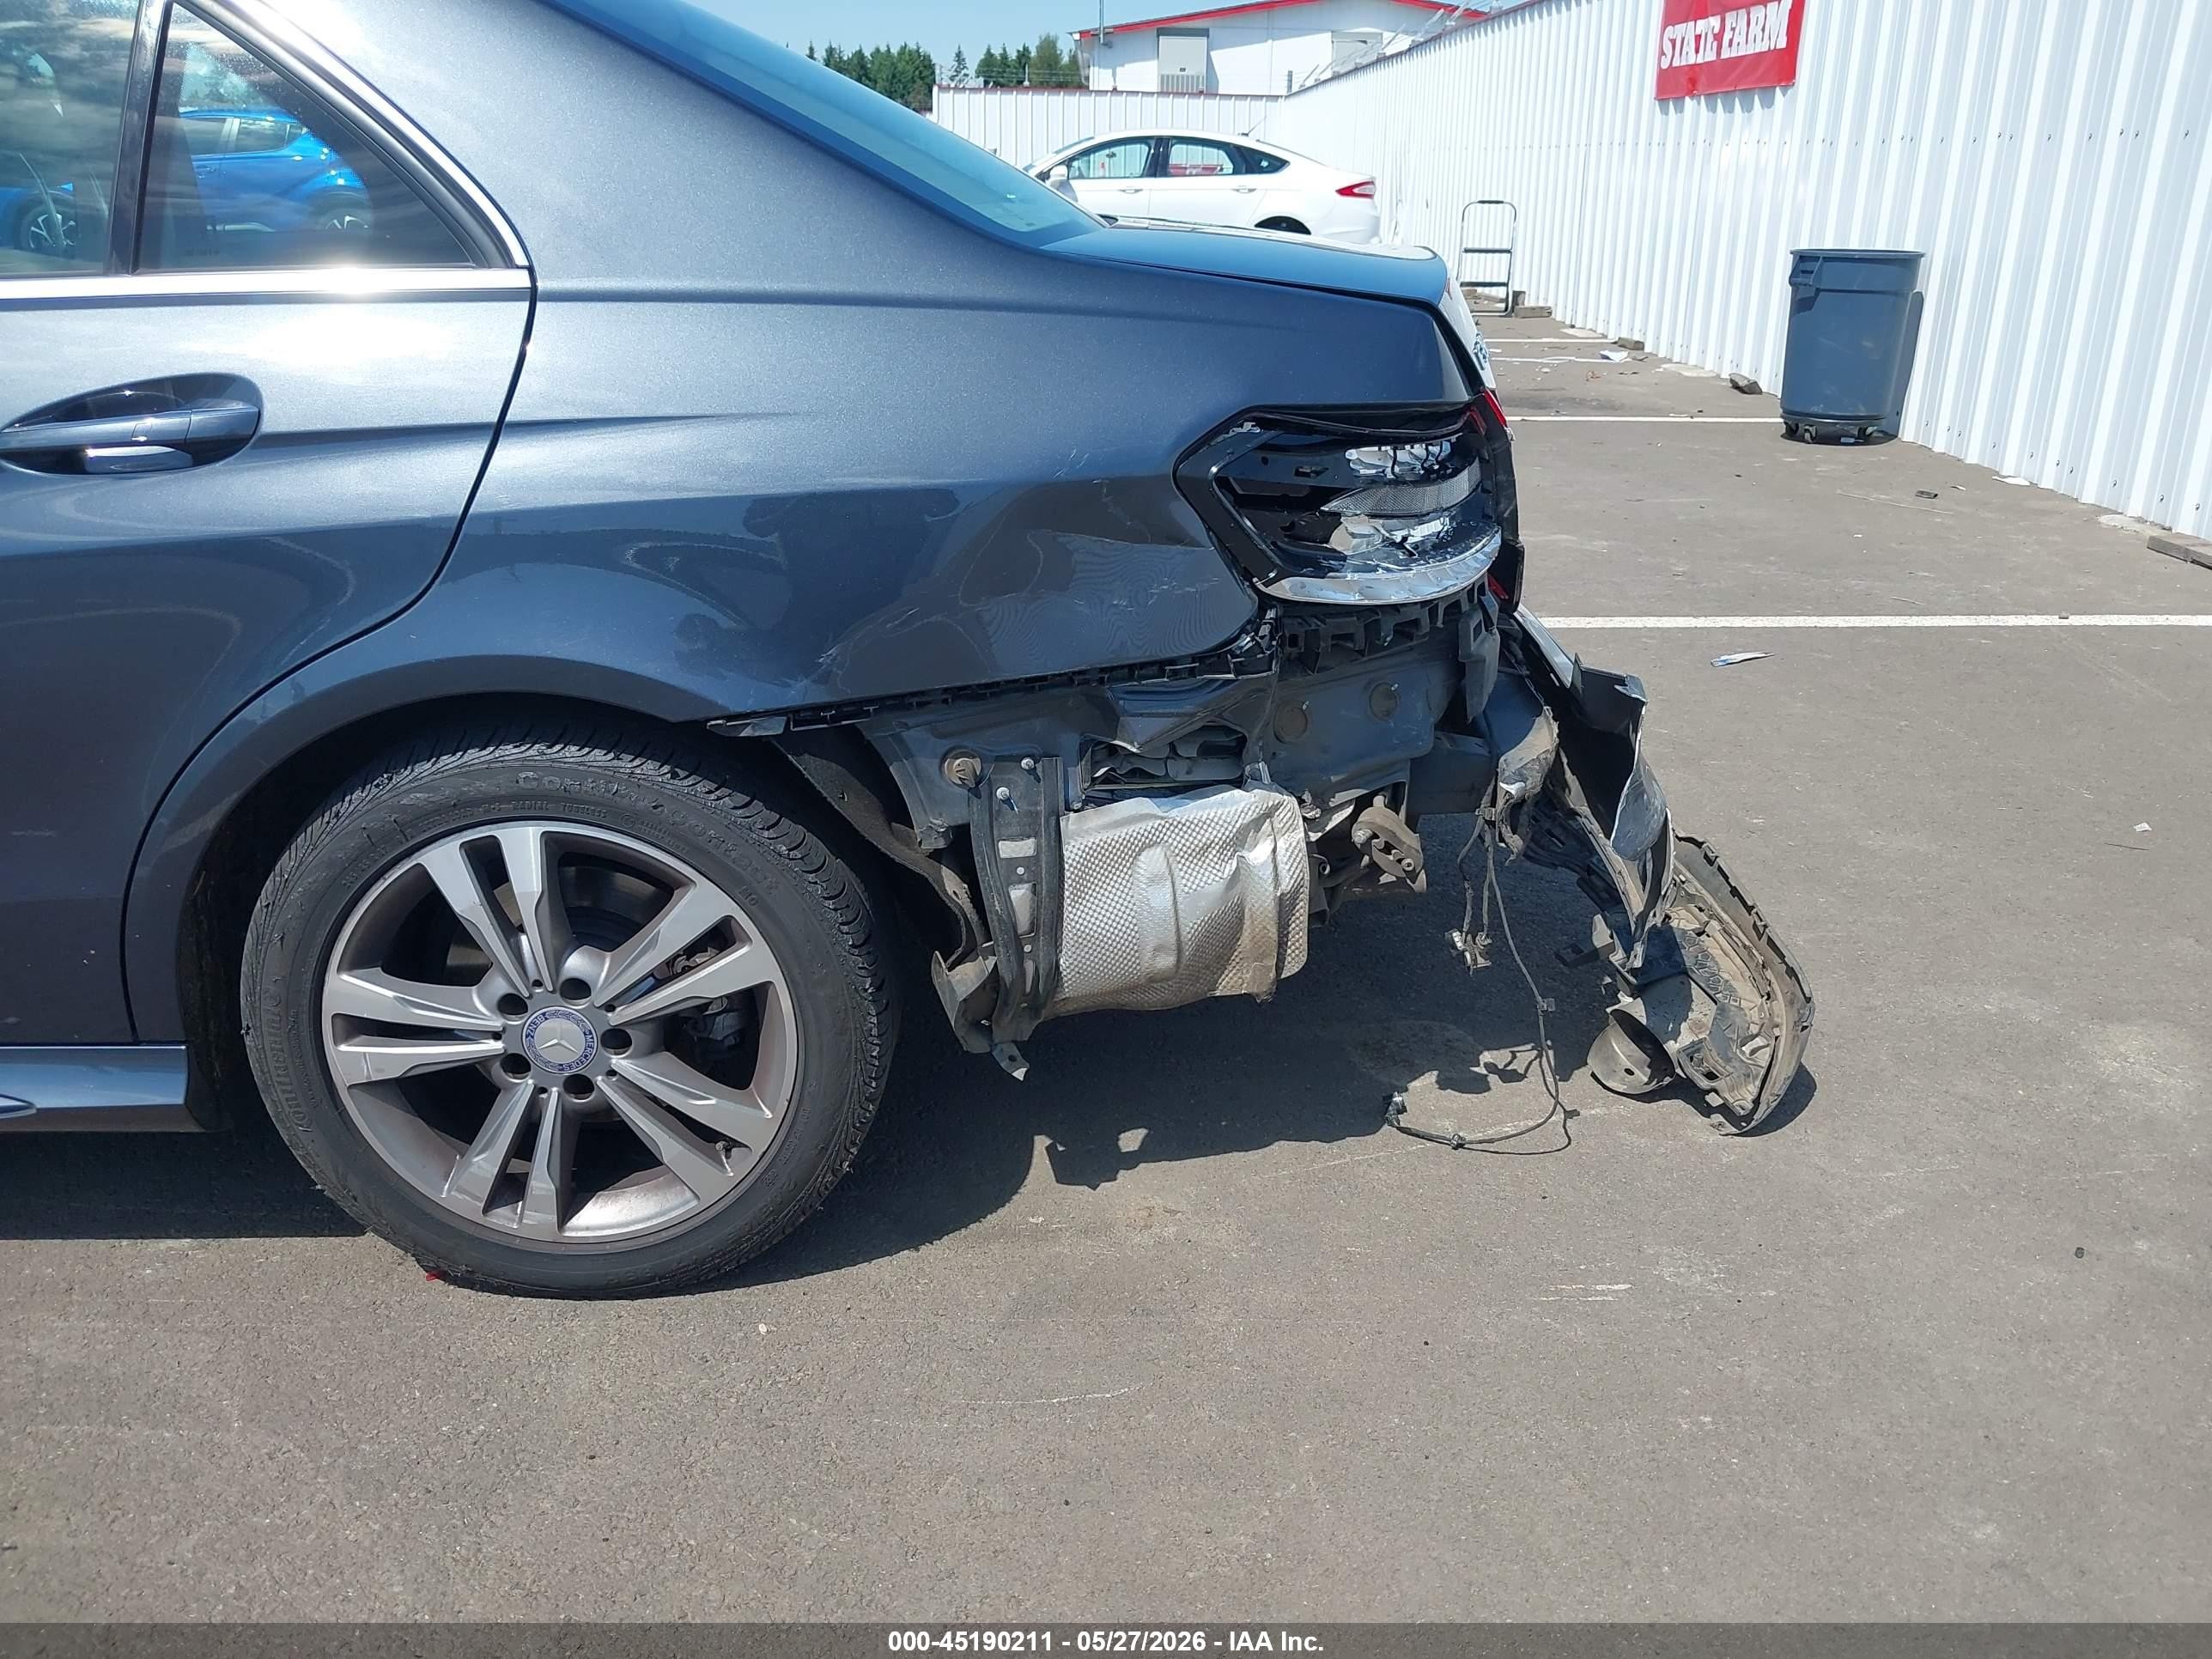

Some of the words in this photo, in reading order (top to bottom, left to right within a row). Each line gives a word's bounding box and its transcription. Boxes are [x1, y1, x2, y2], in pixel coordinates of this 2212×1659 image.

[1661, 15, 1721, 69] STATE
[1720, 0, 1793, 59] FARM
[526, 1015, 545, 1036] BENZ
[563, 1034, 594, 1071] MERCEDES
